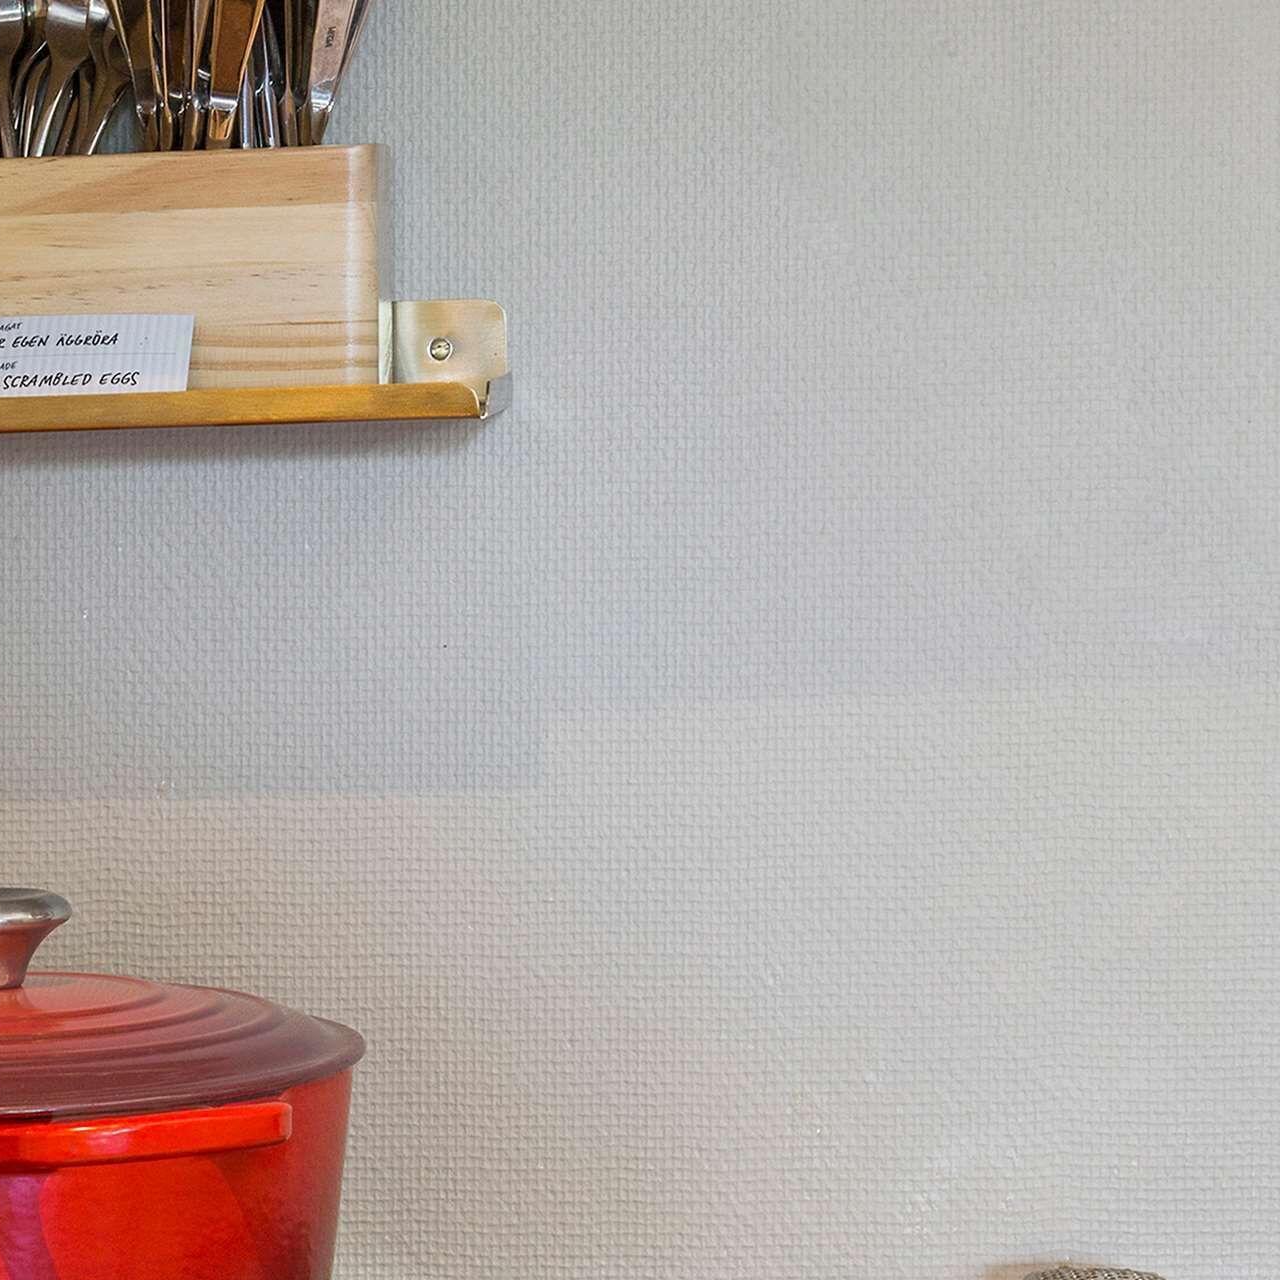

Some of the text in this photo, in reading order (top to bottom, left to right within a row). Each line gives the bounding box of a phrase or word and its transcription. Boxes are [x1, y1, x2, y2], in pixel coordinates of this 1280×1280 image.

[11, 335, 49, 348] EGEN
[56, 331, 119, 347] ÄGGRÖRA
[3, 372, 93, 389] SCRAMBLED
[99, 371, 140, 386] EGGS
